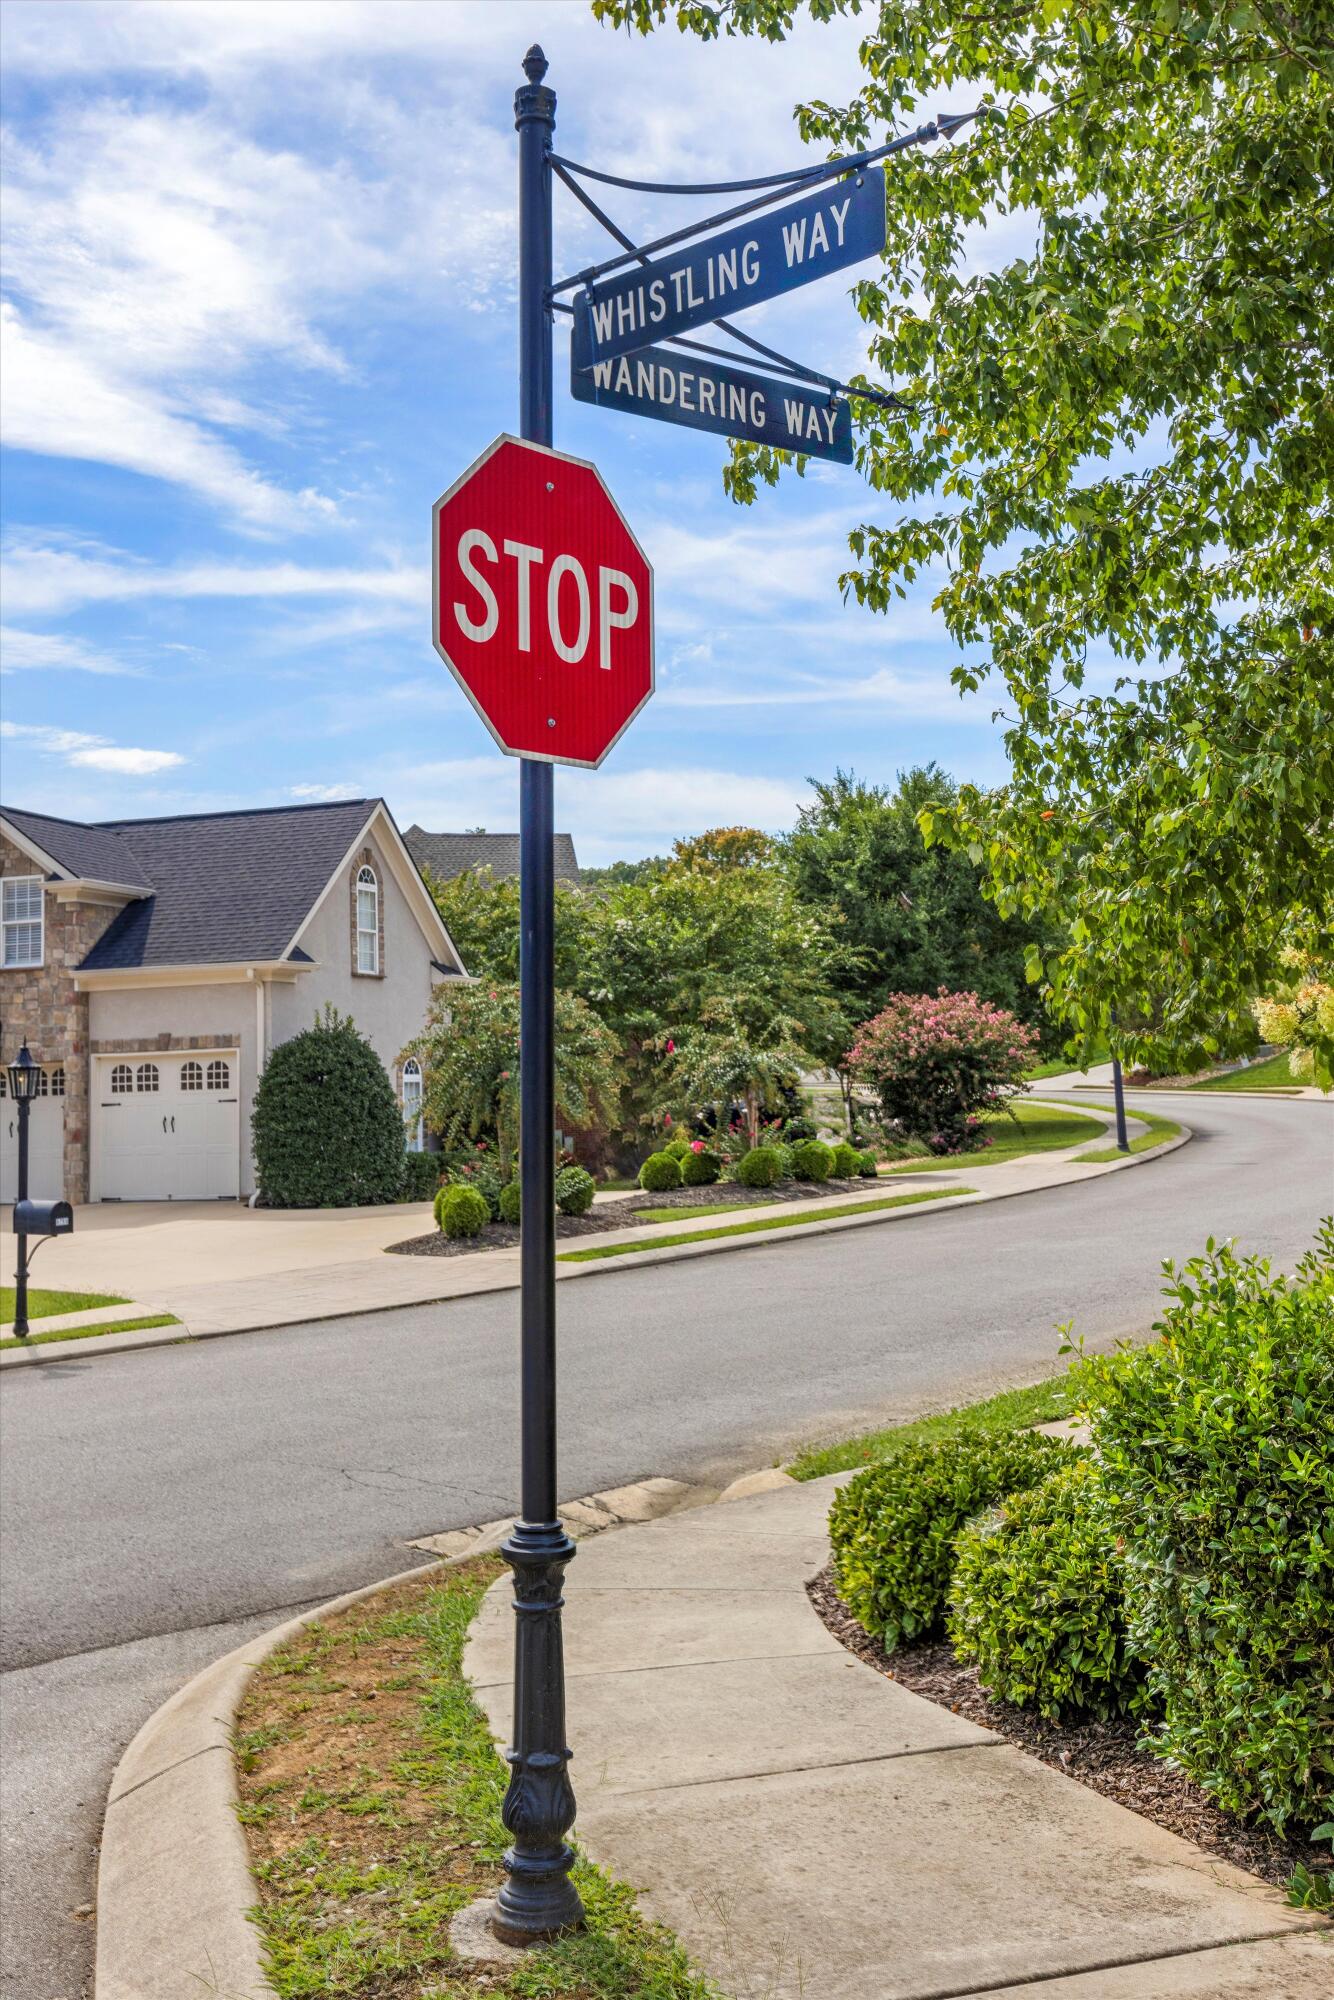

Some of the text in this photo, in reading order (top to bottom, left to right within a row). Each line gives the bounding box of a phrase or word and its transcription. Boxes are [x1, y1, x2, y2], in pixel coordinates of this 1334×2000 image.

[591, 197, 851, 345] WHISTLING WAY
[592, 356, 838, 445] WANDERING WAY
[453, 528, 639, 671] STOP
